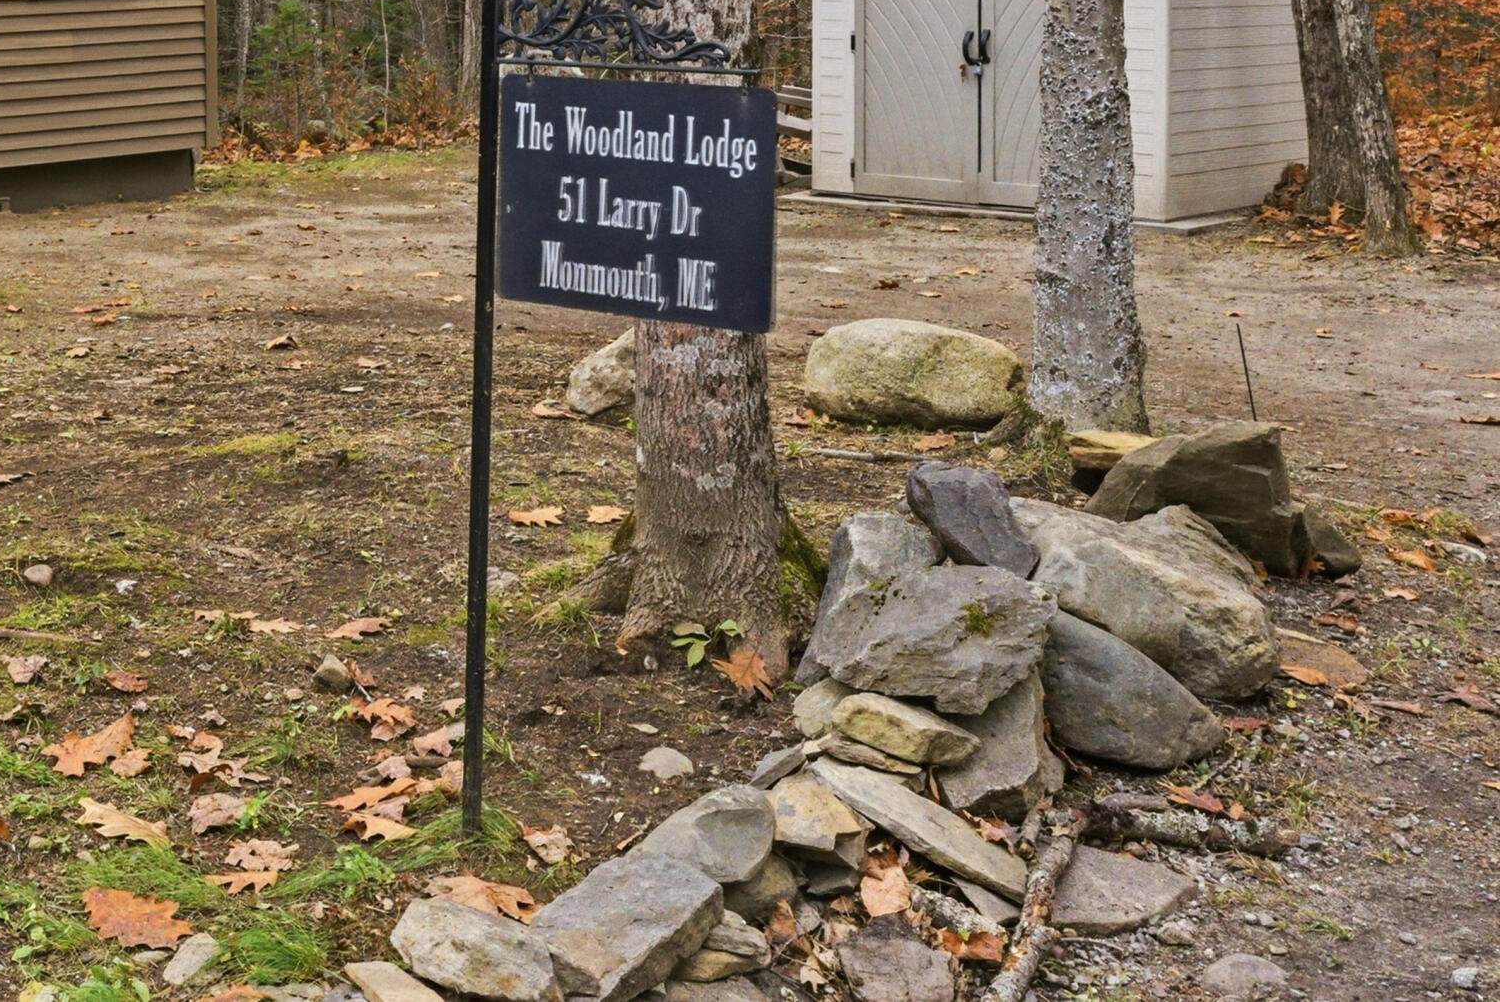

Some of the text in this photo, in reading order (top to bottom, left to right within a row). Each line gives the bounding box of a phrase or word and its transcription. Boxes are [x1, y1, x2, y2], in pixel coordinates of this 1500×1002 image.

[515, 101, 757, 179] The Woodland Lodge
[557, 175, 703, 240] 51 Larry Dr
[540, 240, 718, 312] Monmouth, ME
